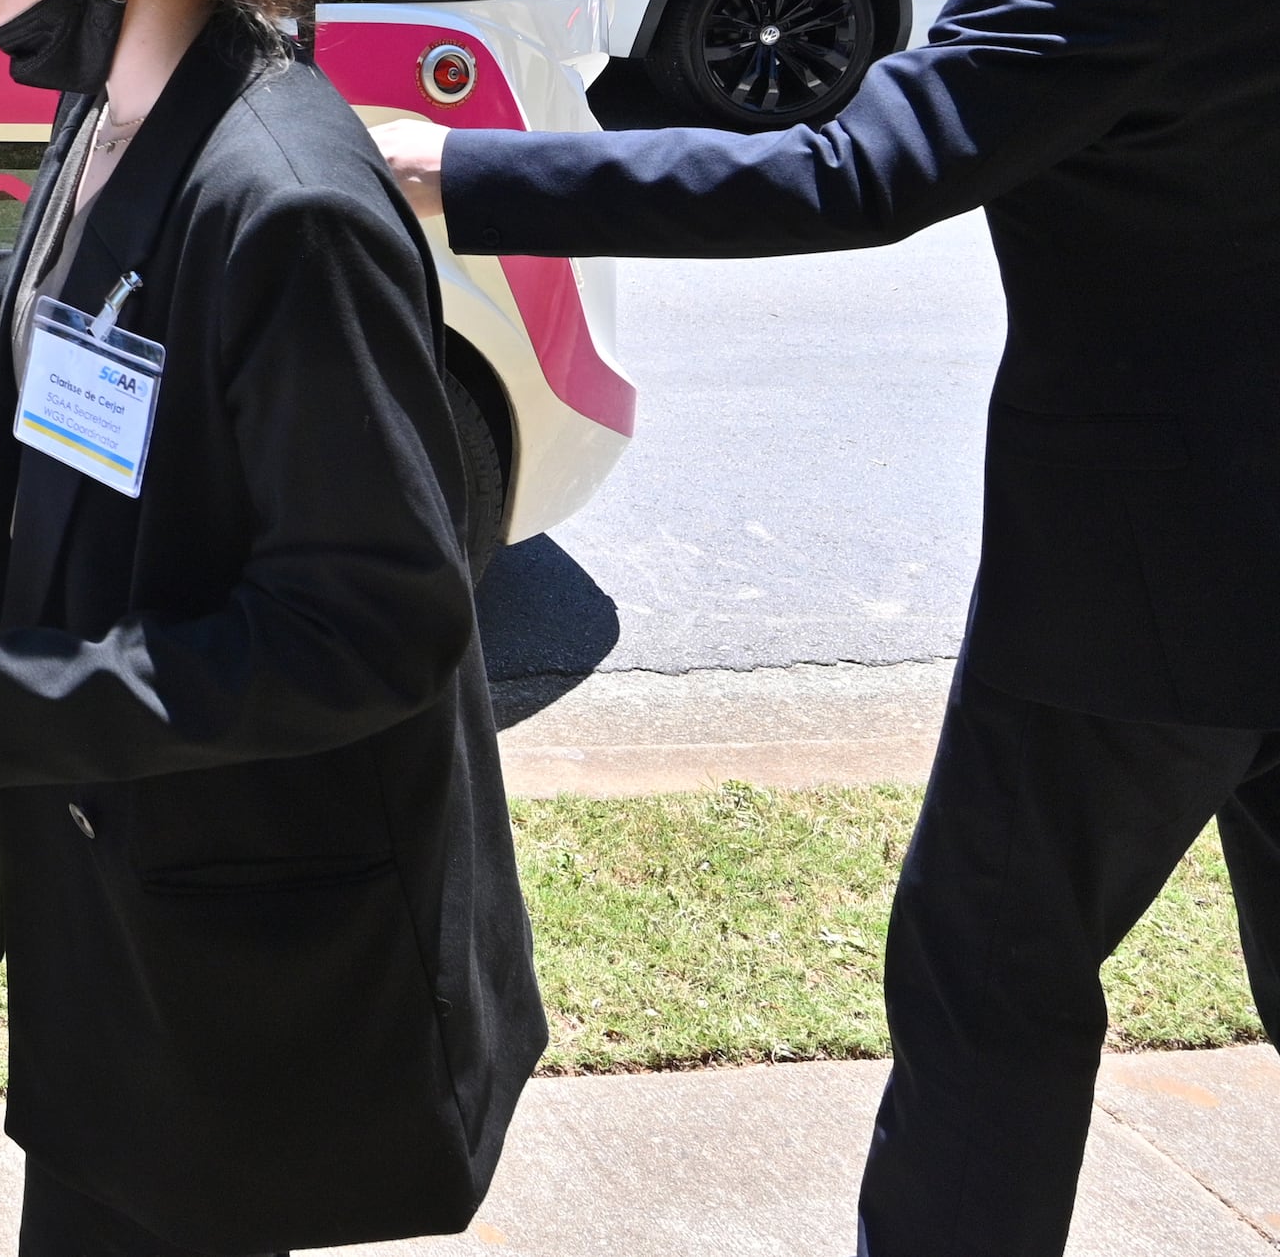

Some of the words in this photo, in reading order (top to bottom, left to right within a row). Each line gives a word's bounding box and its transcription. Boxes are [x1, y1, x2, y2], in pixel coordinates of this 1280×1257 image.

[49, 372, 82, 396] Clarisse
[84, 388, 97, 403] de
[98, 396, 126, 416] Cerjat
[98, 365, 136, 394] 5GAA
[43, 405, 66, 423] WG3
[66, 415, 119, 450] Coordinator
[46, 391, 73, 412] 5GAA
[73, 403, 121, 435] Secretariat
